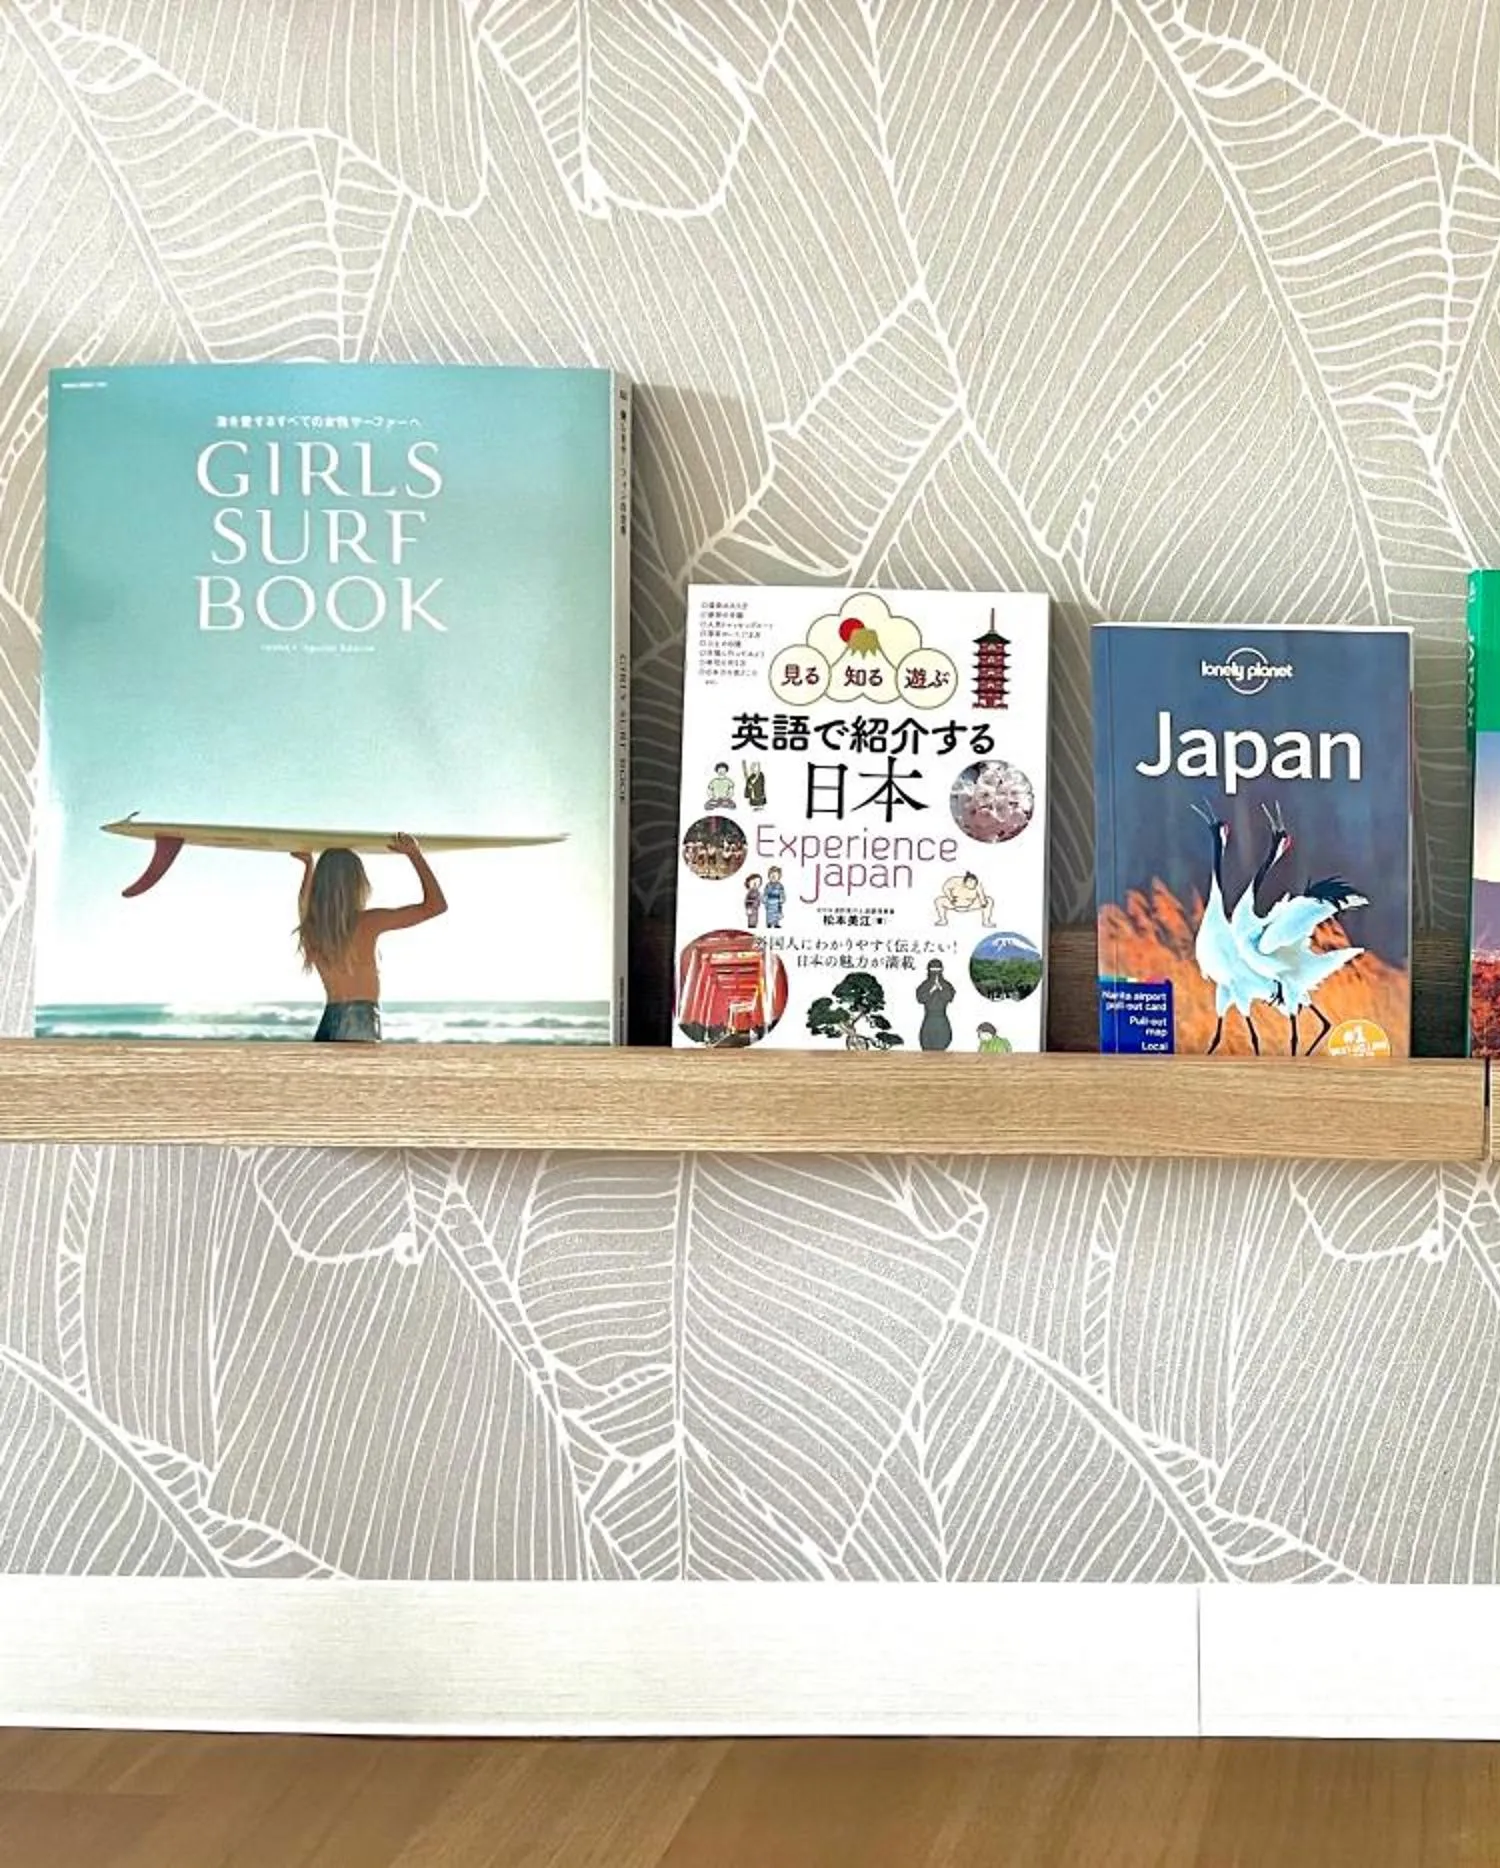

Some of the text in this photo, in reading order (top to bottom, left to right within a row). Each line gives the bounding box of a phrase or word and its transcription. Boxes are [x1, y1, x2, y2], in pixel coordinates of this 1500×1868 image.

[196, 440, 443, 499] GIRLS
[210, 507, 427, 565] SURF
[192, 575, 449, 632] BOOK
[781, 664, 820, 686] 見る
[844, 665, 884, 687] 知る
[904, 667, 951, 689] 遊ぶ
[1201, 660, 1294, 681] lonely planet
[731, 712, 995, 756] 英語で紹介する
[1136, 711, 1361, 795] Japan
[805, 755, 930, 823] 日本
[756, 824, 959, 868] Experience
[1133, 992, 1167, 1002] airport
[1144, 1003, 1167, 1011] card
[1129, 1016, 1167, 1026] Pull-out
[1145, 1029, 1168, 1037] map
[1141, 1042, 1168, 1051] Local
